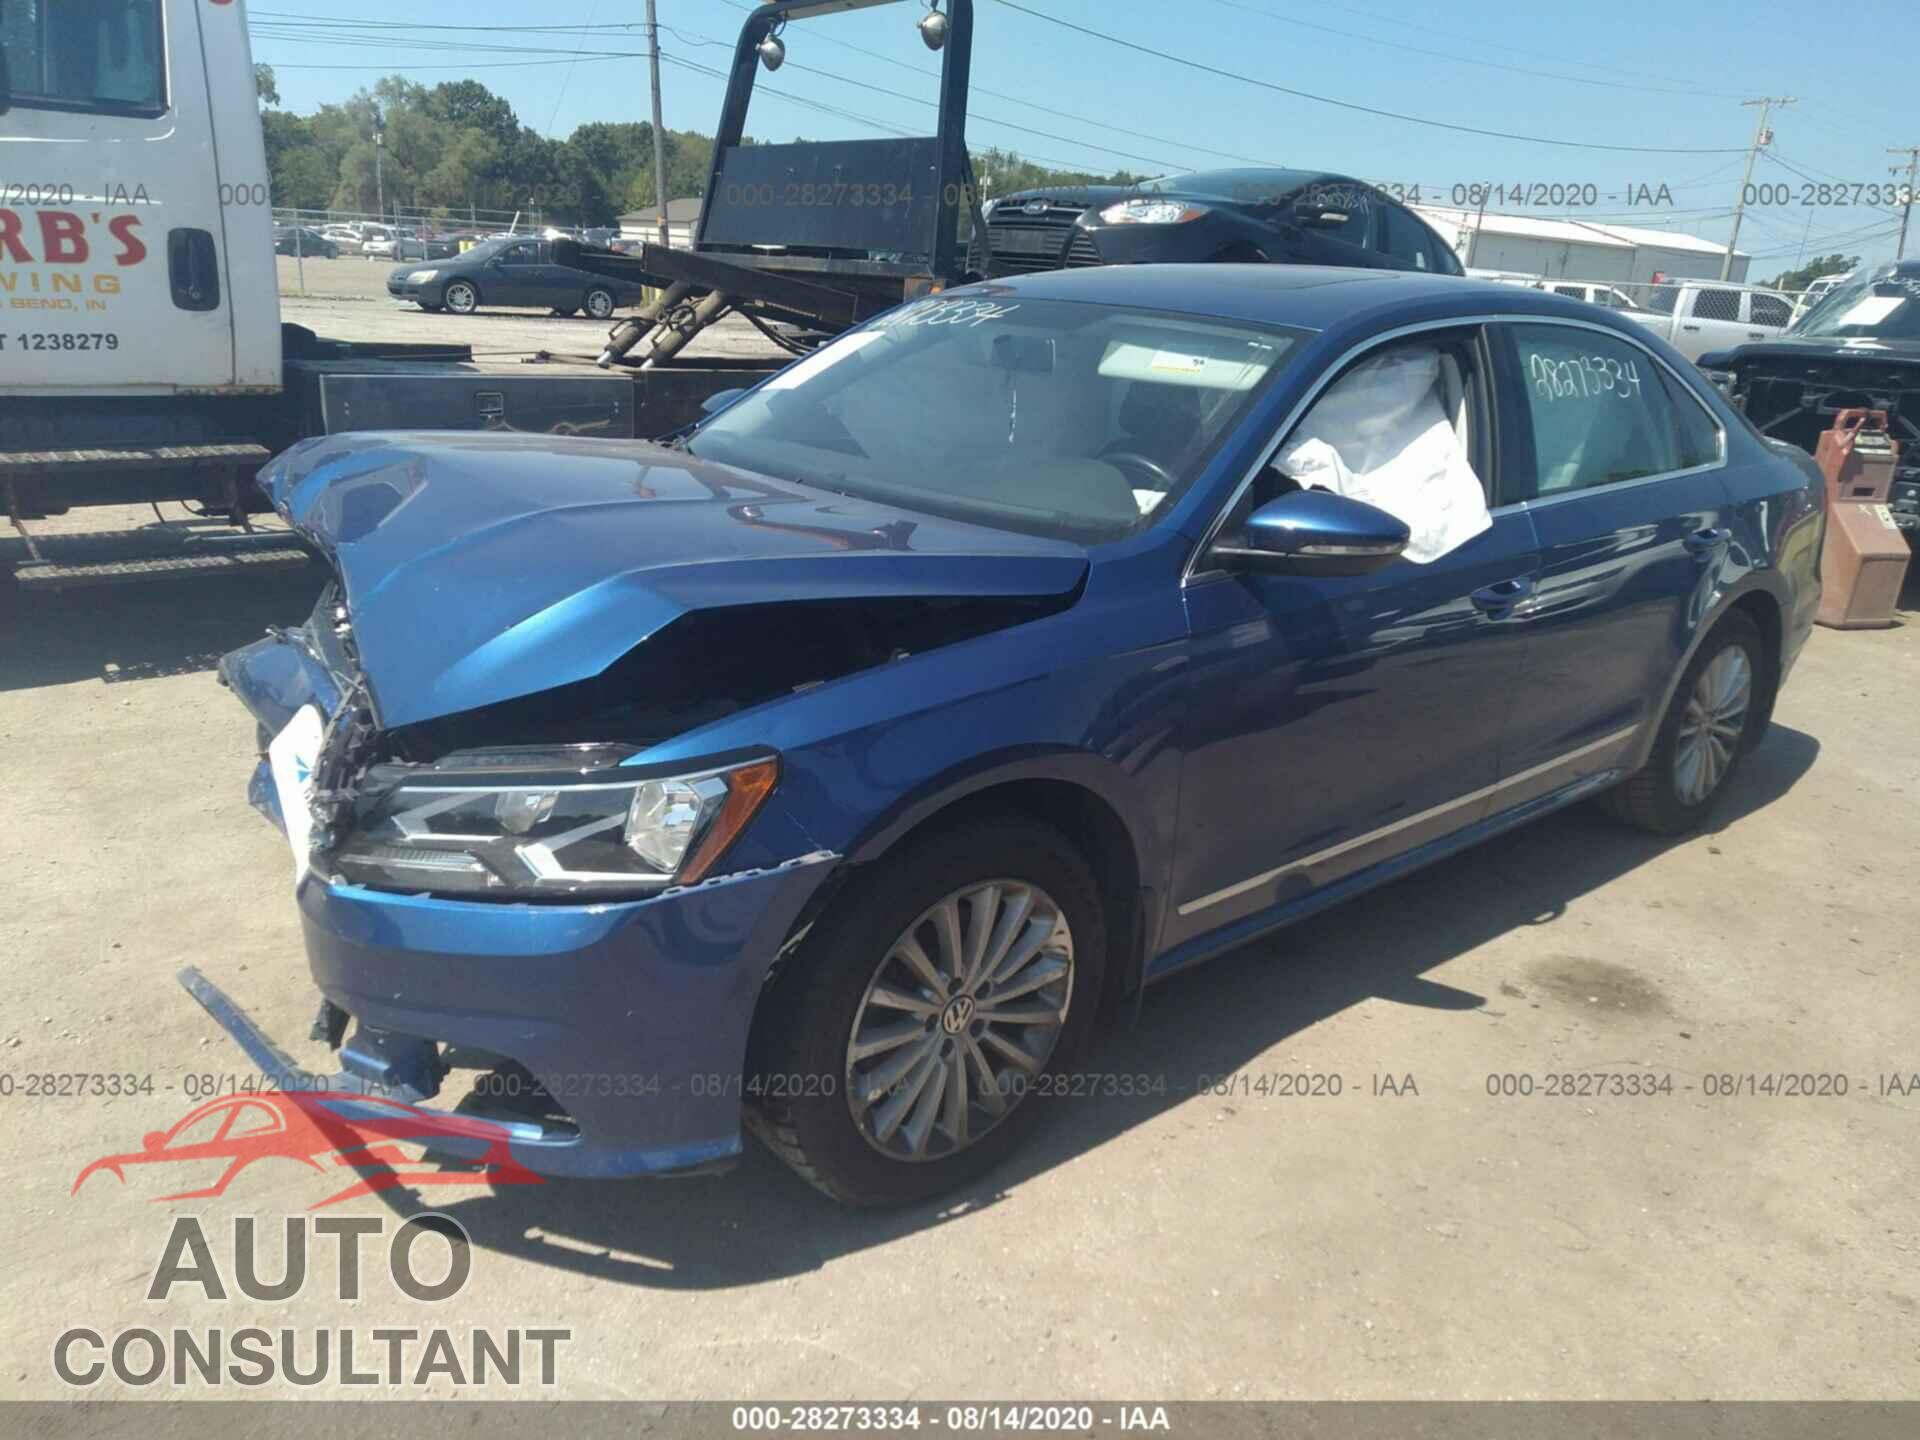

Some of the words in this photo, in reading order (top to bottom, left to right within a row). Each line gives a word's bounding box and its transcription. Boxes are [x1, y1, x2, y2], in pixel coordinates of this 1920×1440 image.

[85, 298, 108, 312] IN
[17, 332, 119, 351] 1238279
[1530, 353, 1641, 402] 28273334
